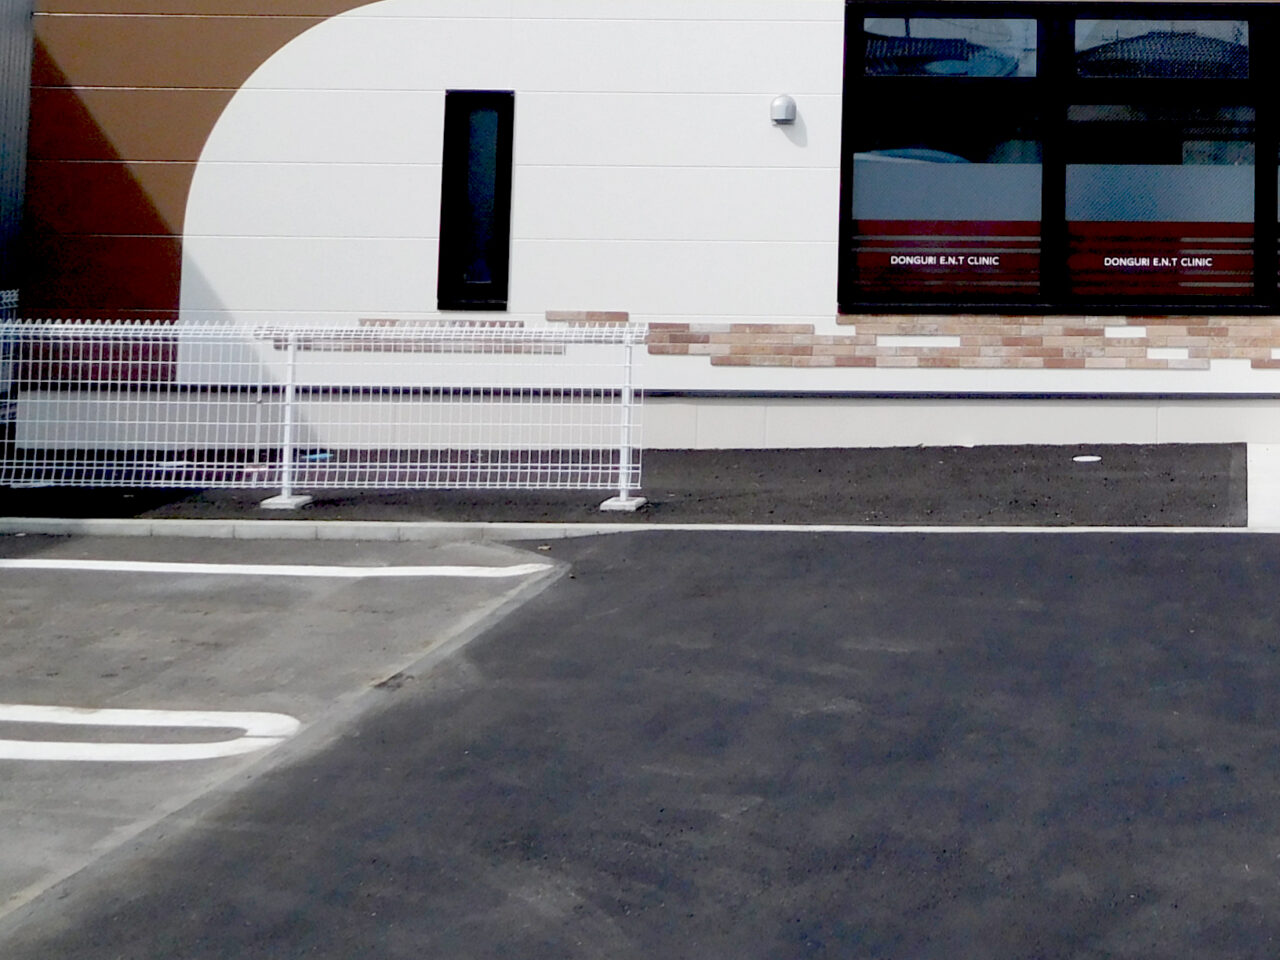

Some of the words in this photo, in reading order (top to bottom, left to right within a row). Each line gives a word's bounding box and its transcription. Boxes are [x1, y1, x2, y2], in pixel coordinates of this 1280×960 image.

[890, 255, 937, 265] DONGURI
[939, 255, 965, 265] E.N.T
[967, 255, 1000, 265] CLINIC
[1104, 257, 1150, 267] DONGURI
[1152, 257, 1178, 267] E.N.T
[1180, 257, 1213, 267] CLINIC
